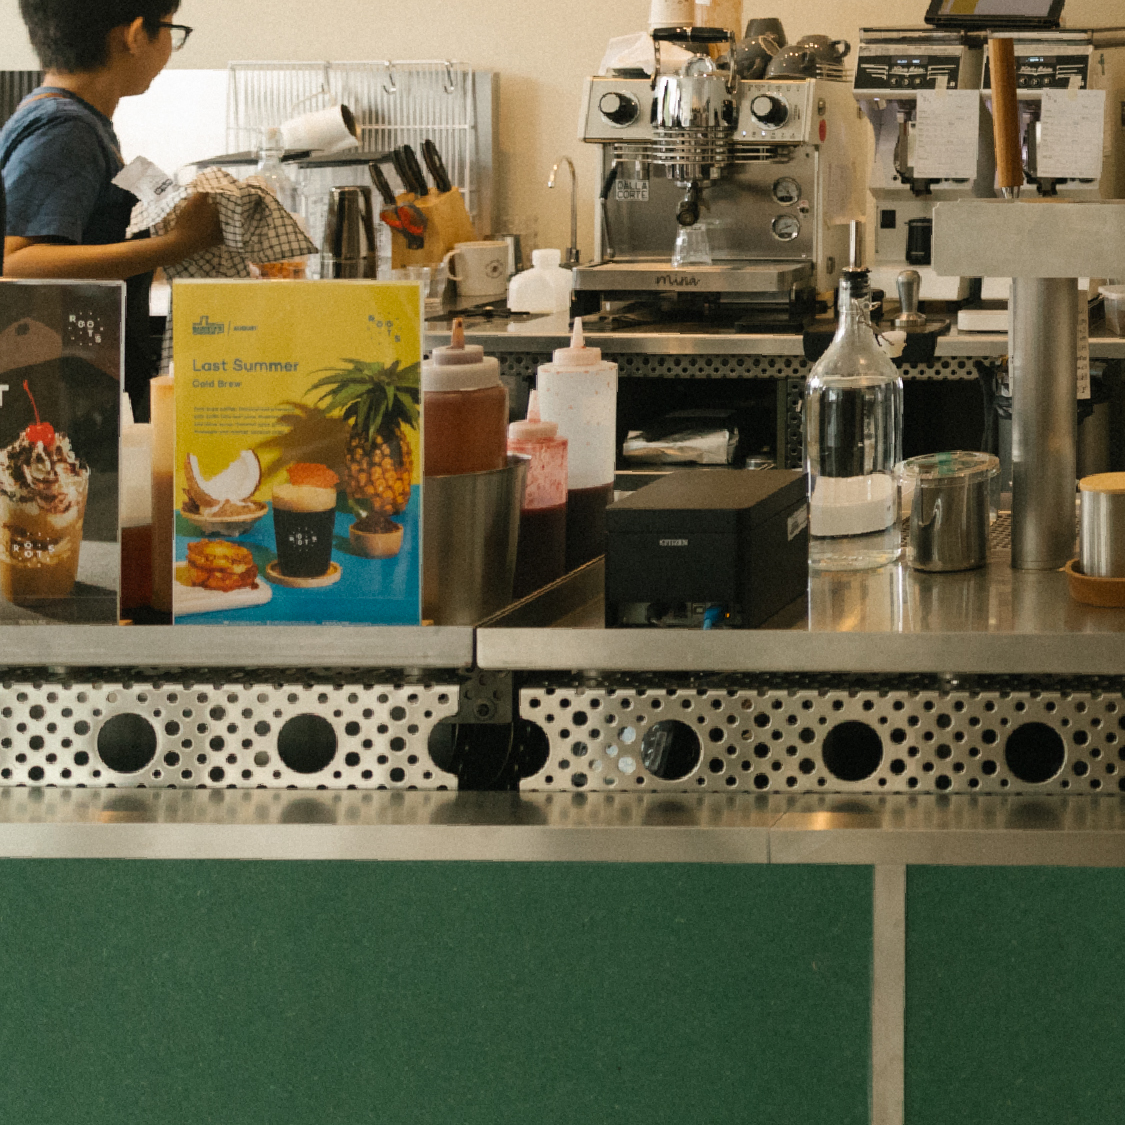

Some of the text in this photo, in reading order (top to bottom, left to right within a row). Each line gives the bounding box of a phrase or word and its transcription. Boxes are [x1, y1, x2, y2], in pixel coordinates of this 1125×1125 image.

[617, 181, 648, 190] DALLA
[617, 190, 648, 199] CORTE
[192, 358, 299, 373] Last Summer
[192, 379, 242, 388] Cold Brew
